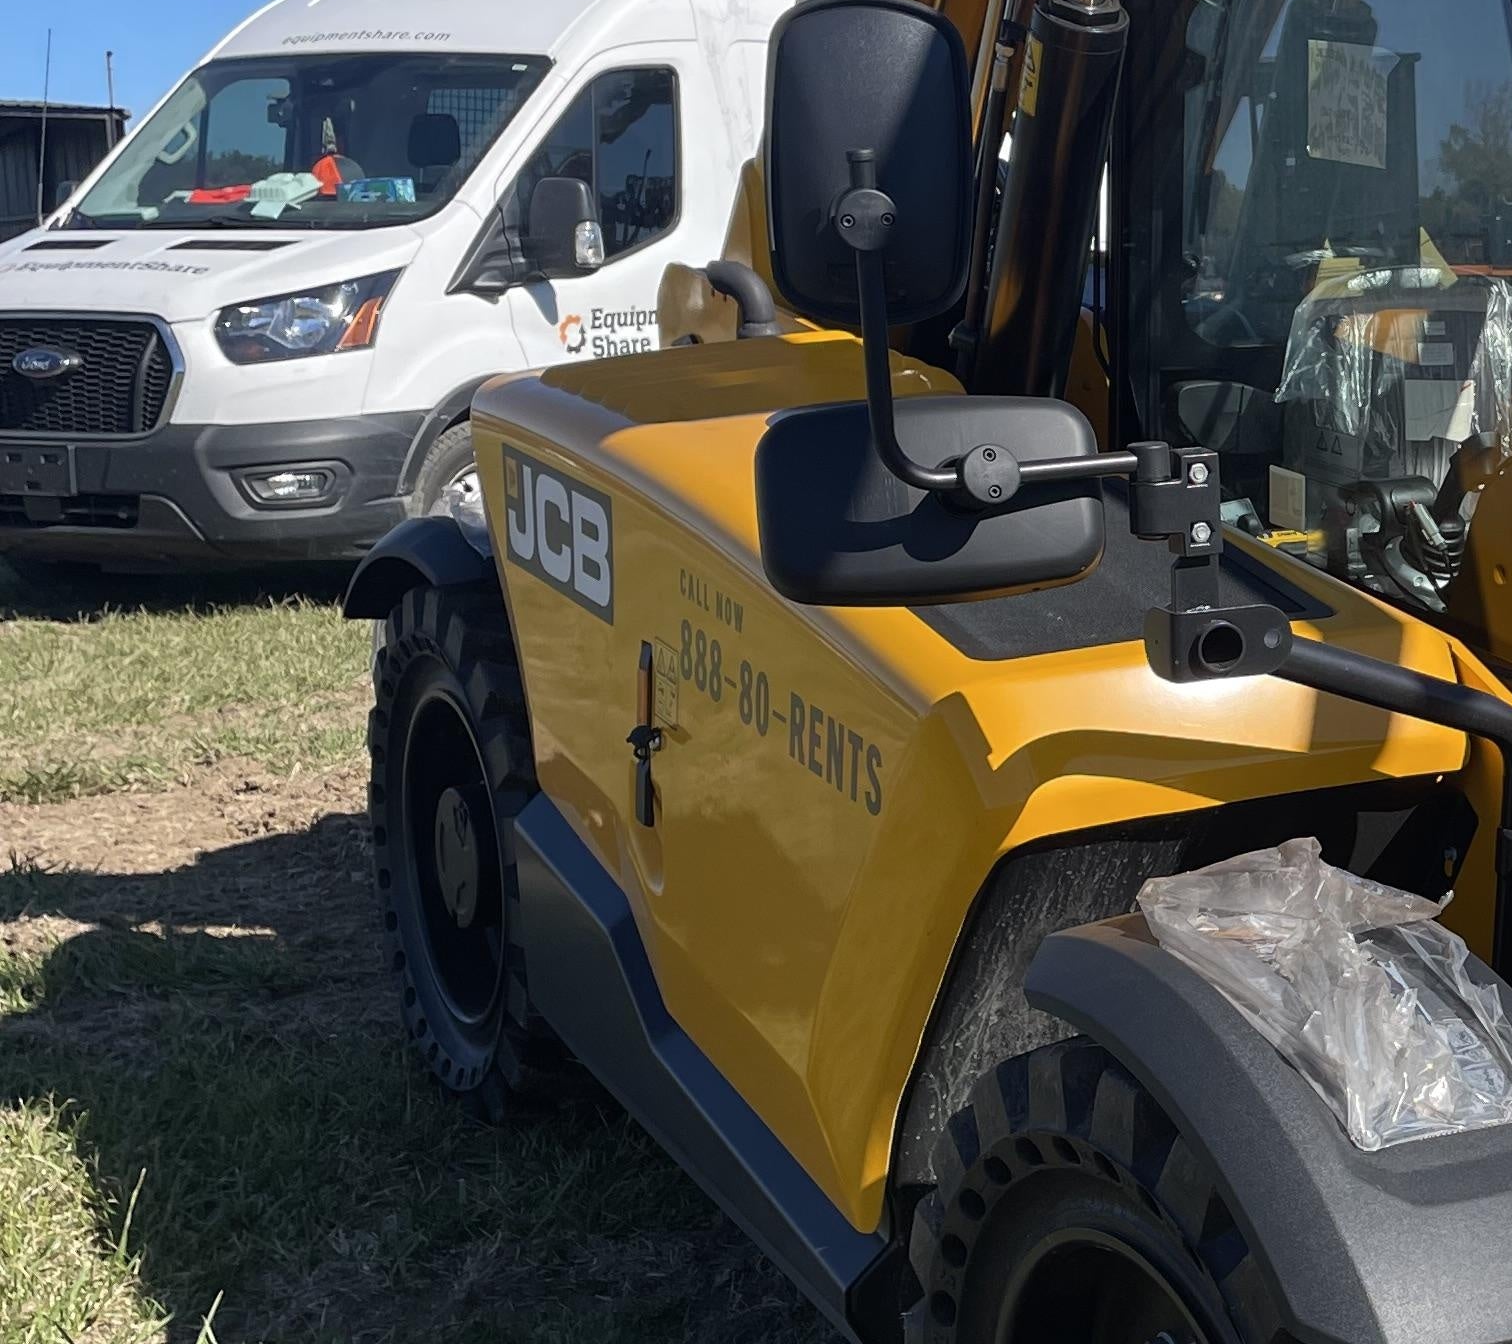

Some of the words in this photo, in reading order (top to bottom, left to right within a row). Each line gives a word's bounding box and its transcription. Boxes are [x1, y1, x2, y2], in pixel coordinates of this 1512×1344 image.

[507, 464, 611, 608] JCB
[679, 568, 710, 612] CALL
[716, 590, 744, 633] NOW
[680, 619, 883, 816] 888-80-RENTS
